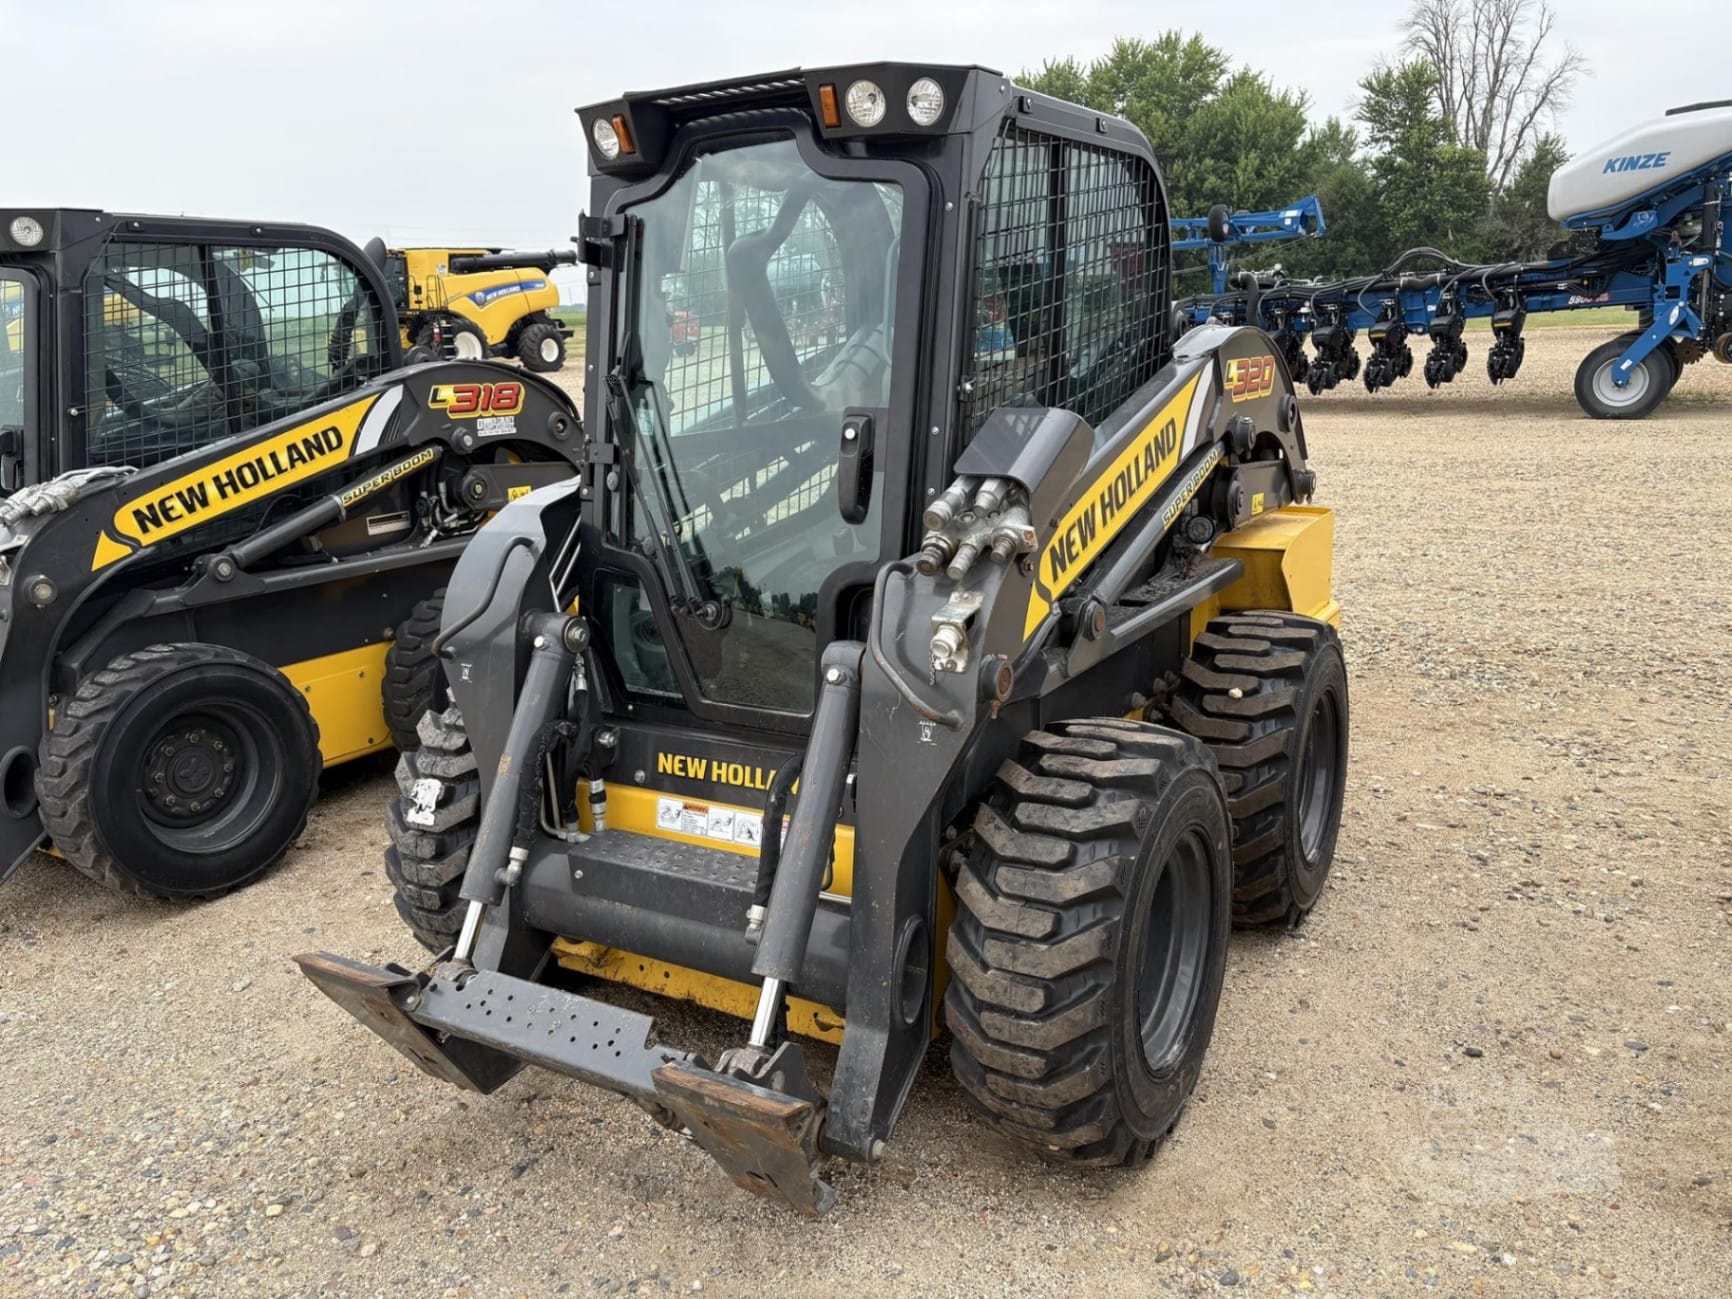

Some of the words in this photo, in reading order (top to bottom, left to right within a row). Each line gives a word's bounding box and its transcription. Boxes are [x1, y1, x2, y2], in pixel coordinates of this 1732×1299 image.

[1602, 151, 1671, 174] KINZE
[428, 382, 525, 419] L318
[1224, 355, 1275, 403] L320
[132, 481, 210, 534] NEW
[212, 426, 343, 499] HOLLAND
[342, 471, 393, 507] SUPER
[392, 447, 434, 479] BOOM
[1049, 503, 1096, 583] NEW
[1100, 417, 1177, 528] HOLLAND
[1162, 480, 1193, 530] SUPER
[1191, 449, 1217, 489] BOOM
[657, 752, 707, 780] NEW
